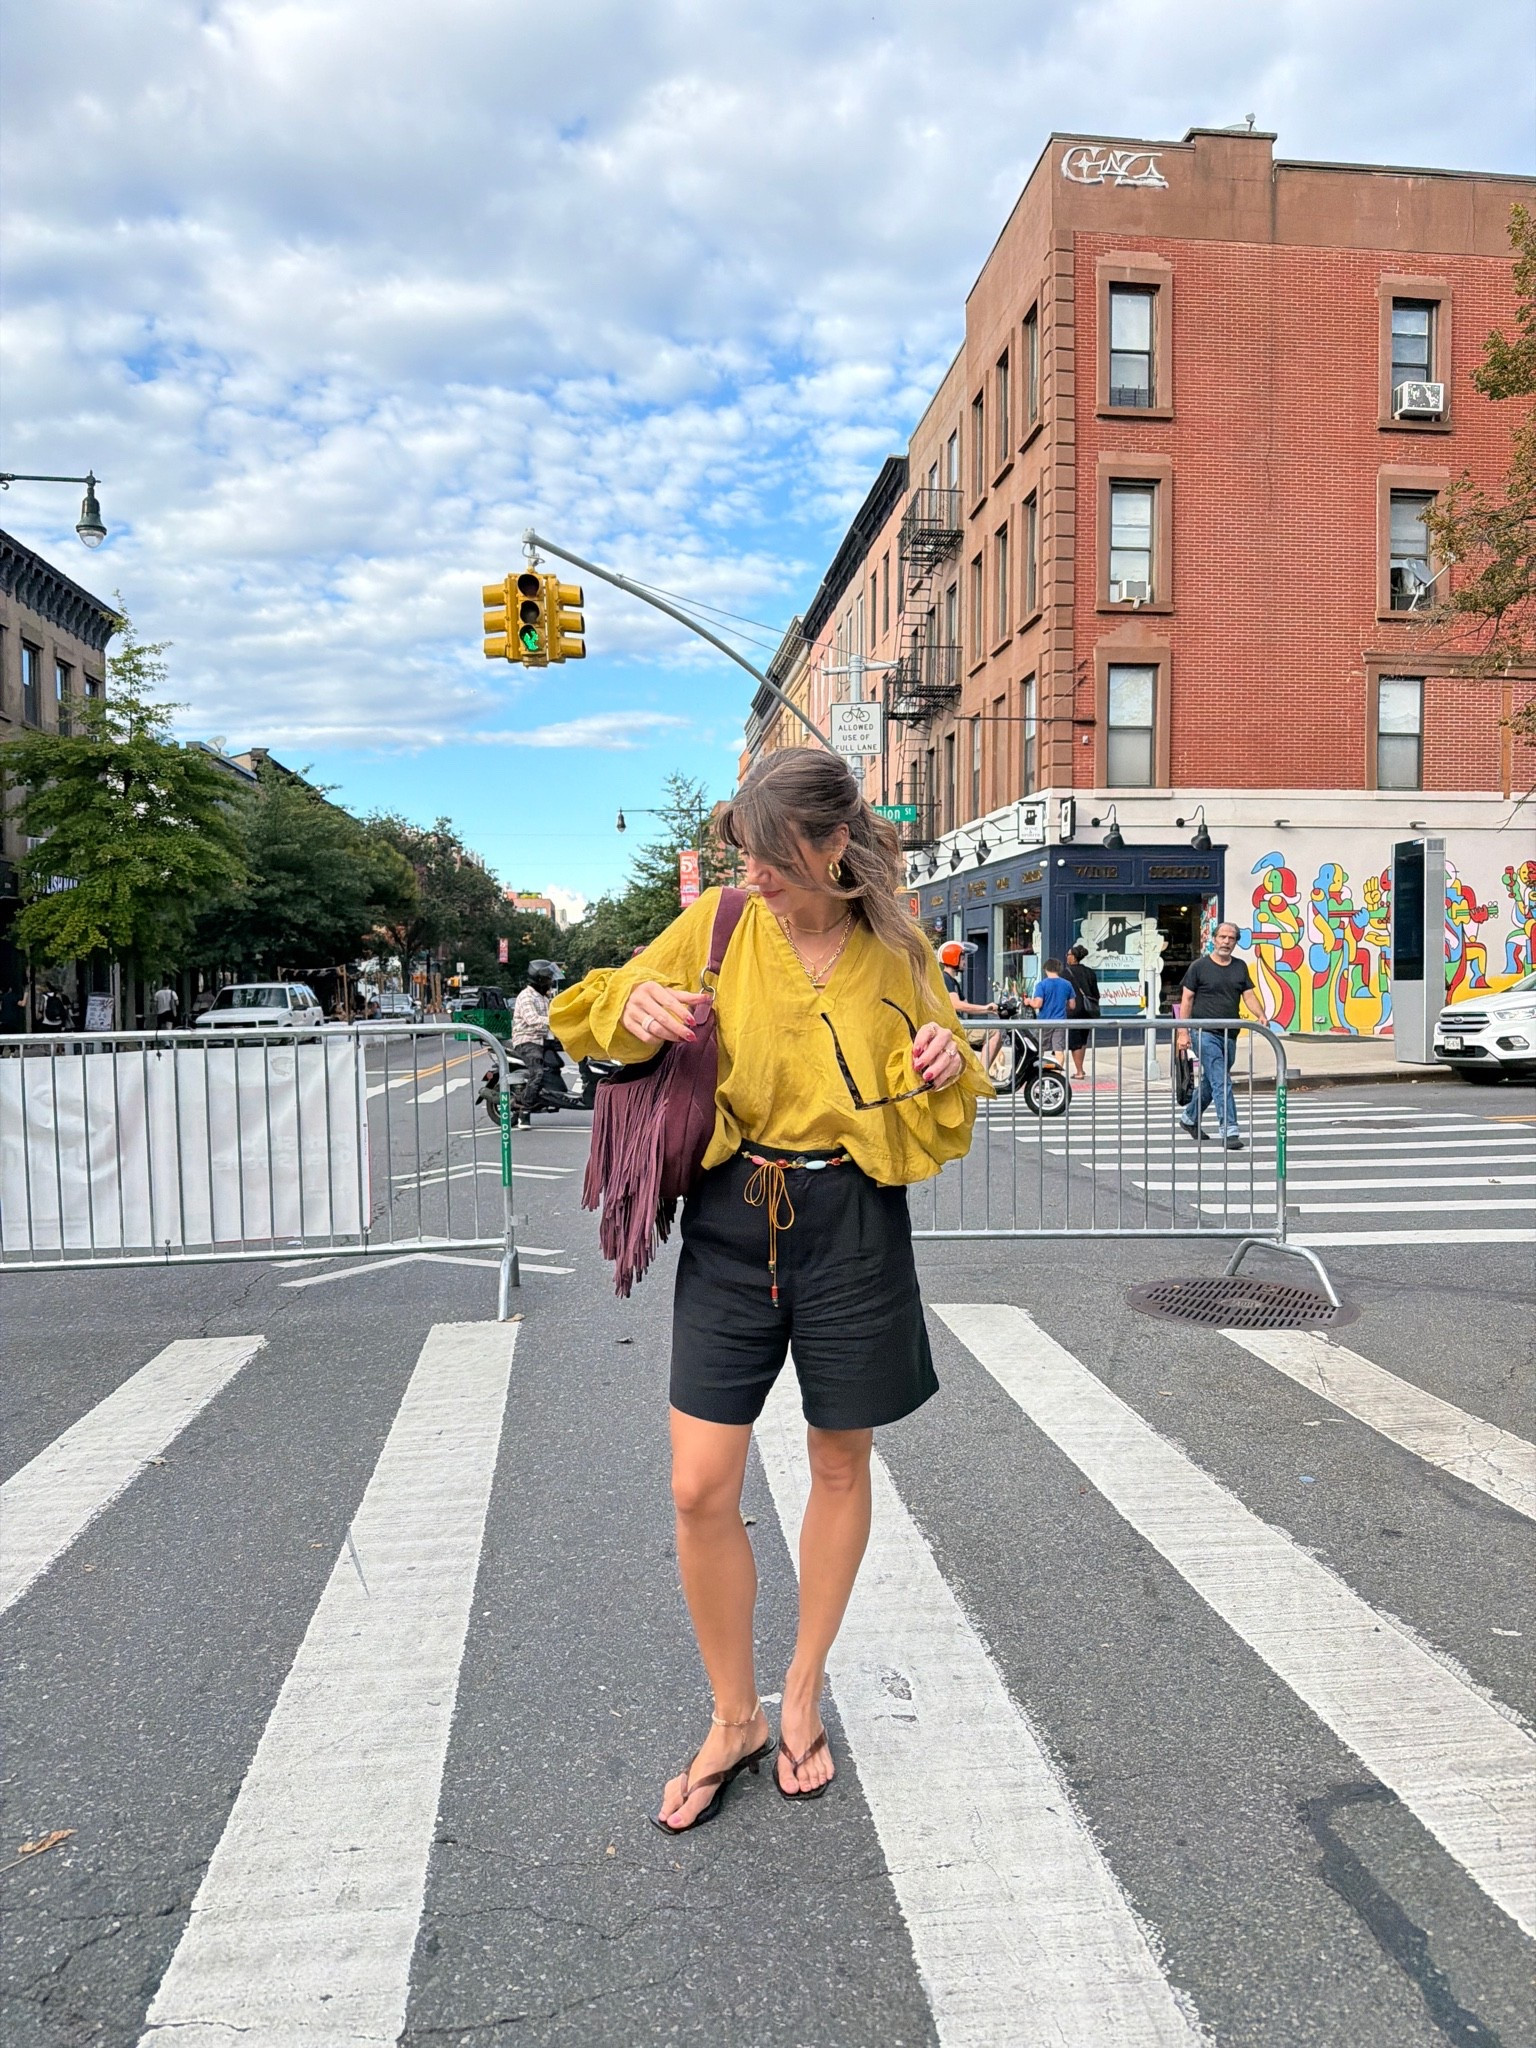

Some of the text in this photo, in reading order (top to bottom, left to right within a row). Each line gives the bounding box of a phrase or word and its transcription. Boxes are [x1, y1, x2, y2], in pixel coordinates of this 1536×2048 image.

[873, 807, 911, 819] nion St
[501, 1094, 509, 1119] NYC
